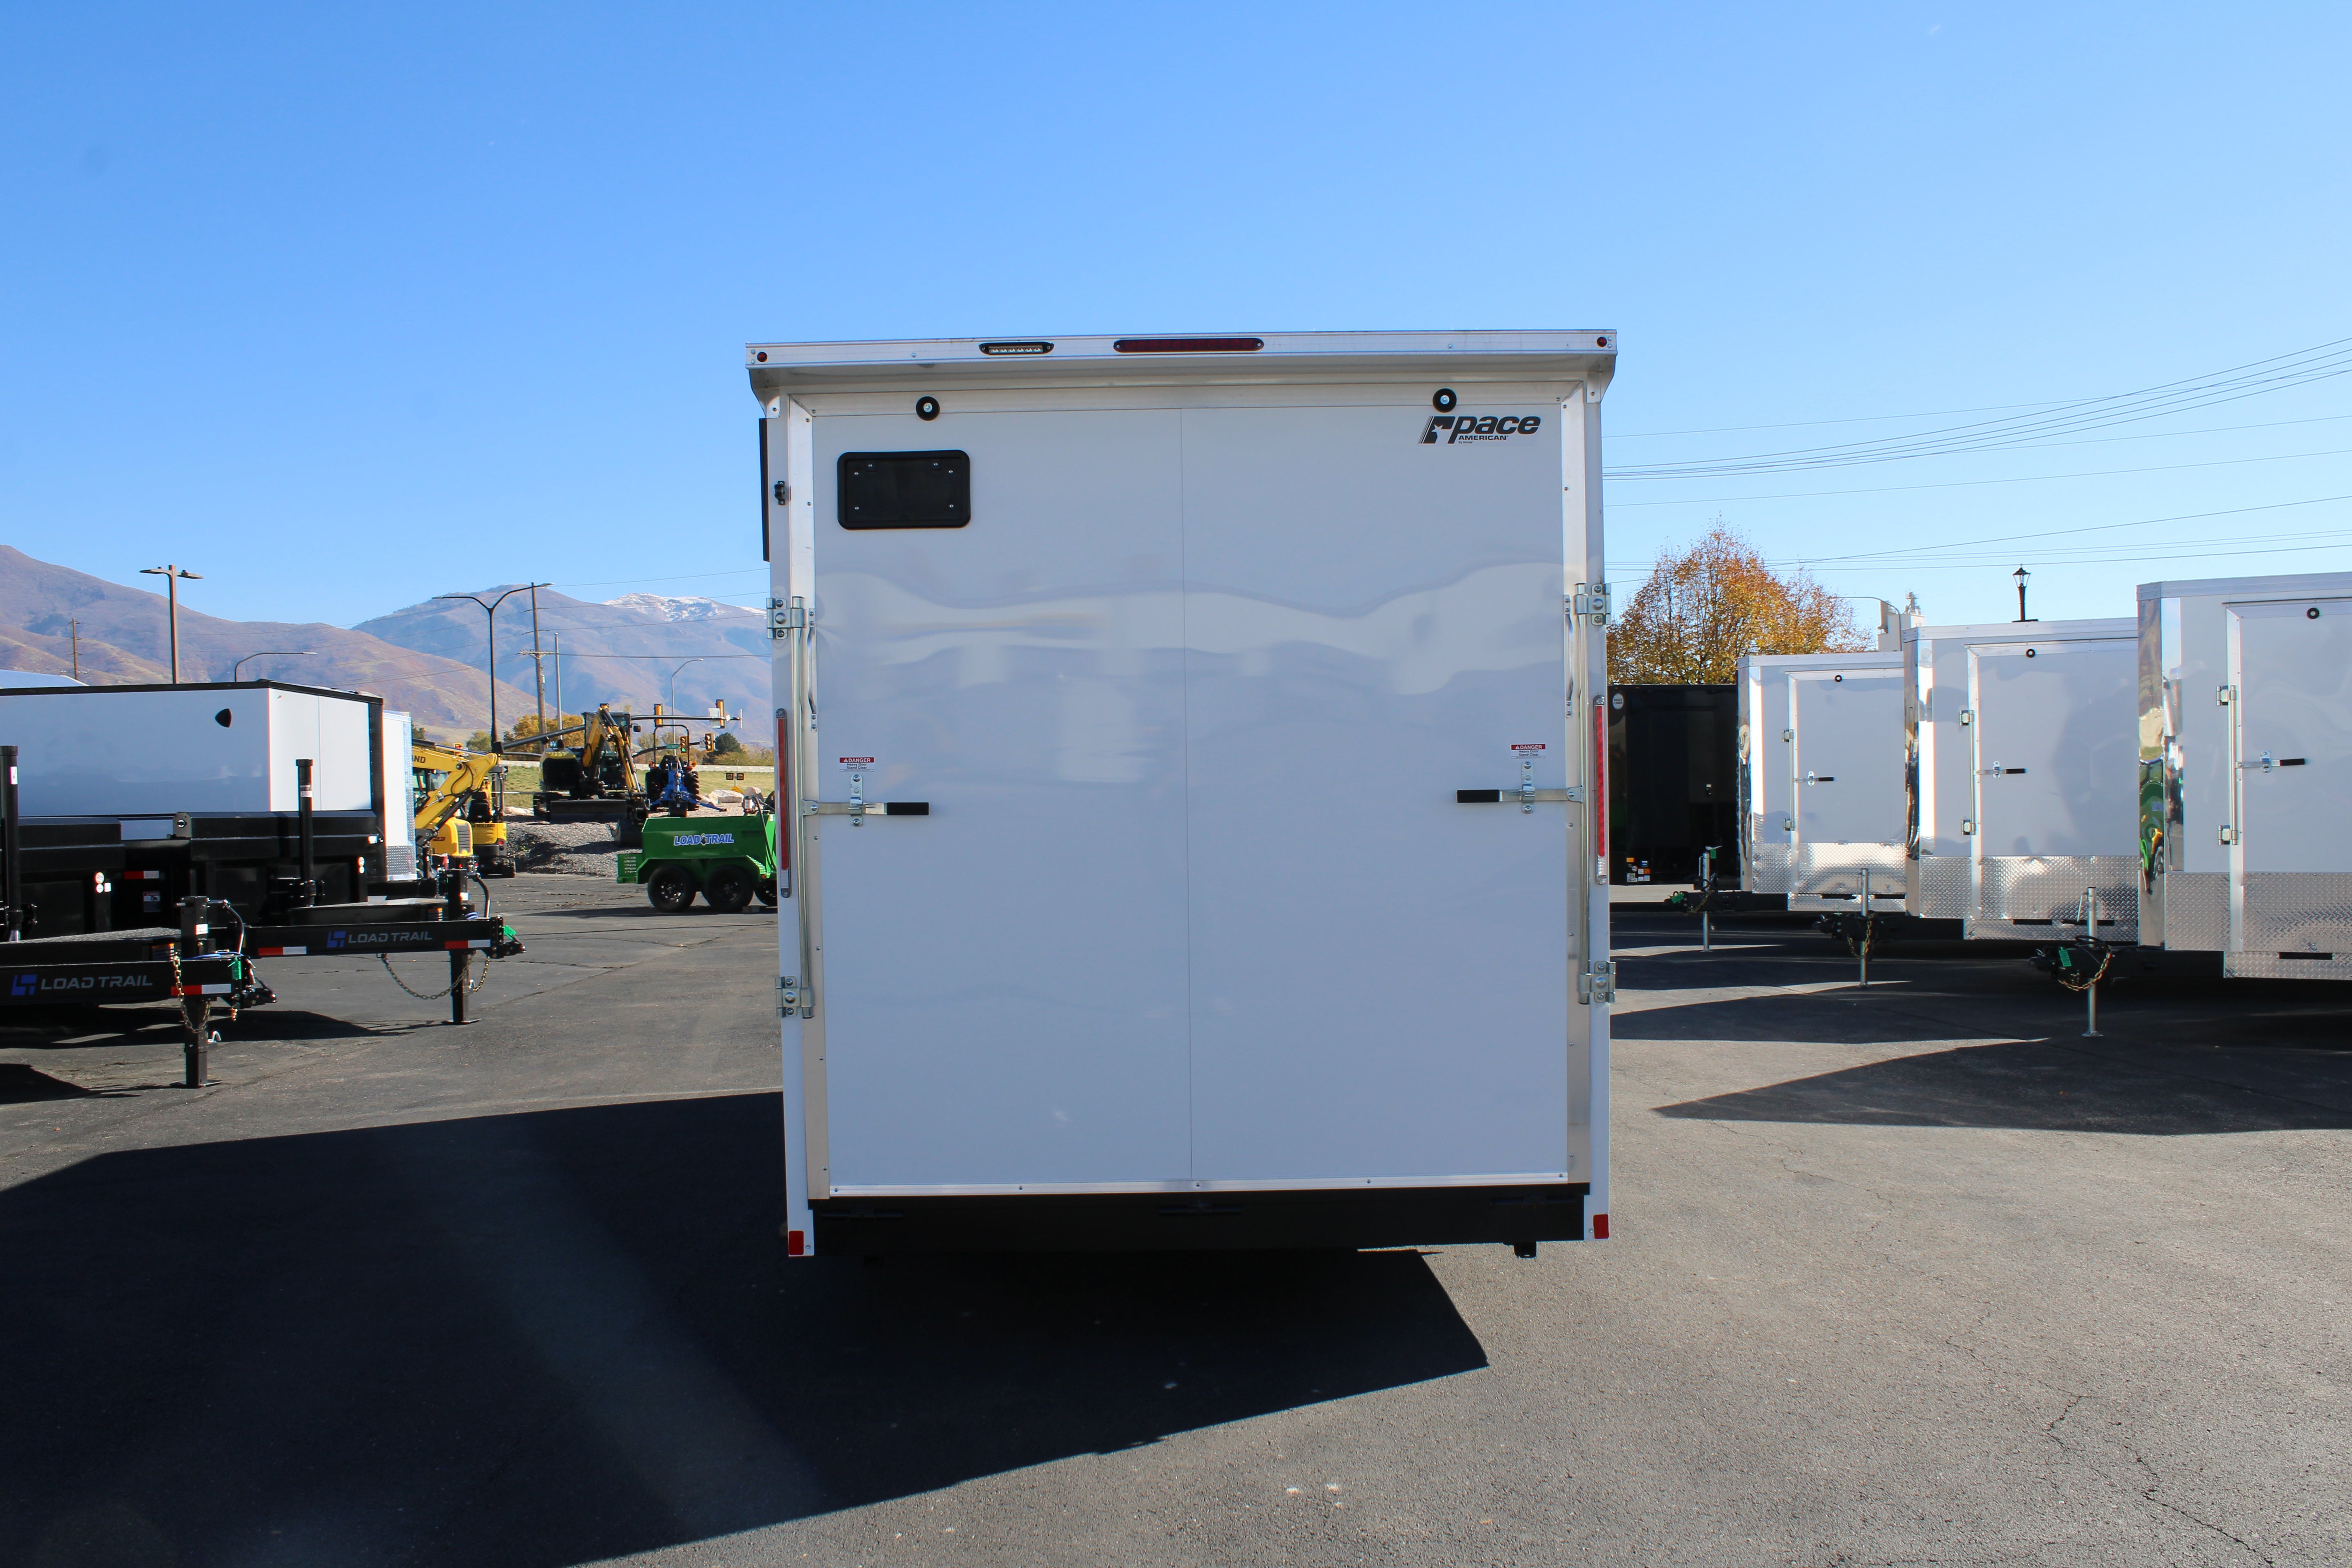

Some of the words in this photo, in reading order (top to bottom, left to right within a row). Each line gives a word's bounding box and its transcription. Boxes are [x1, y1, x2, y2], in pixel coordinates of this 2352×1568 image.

[1448, 416, 1541, 444] pace
[674, 835, 701, 846] LOAD
[705, 833, 734, 844] TRAIL
[348, 933, 388, 944] LOAD
[391, 931, 432, 942] TRAIL
[41, 978, 94, 990] LOAD
[98, 975, 153, 988] TRAIL
